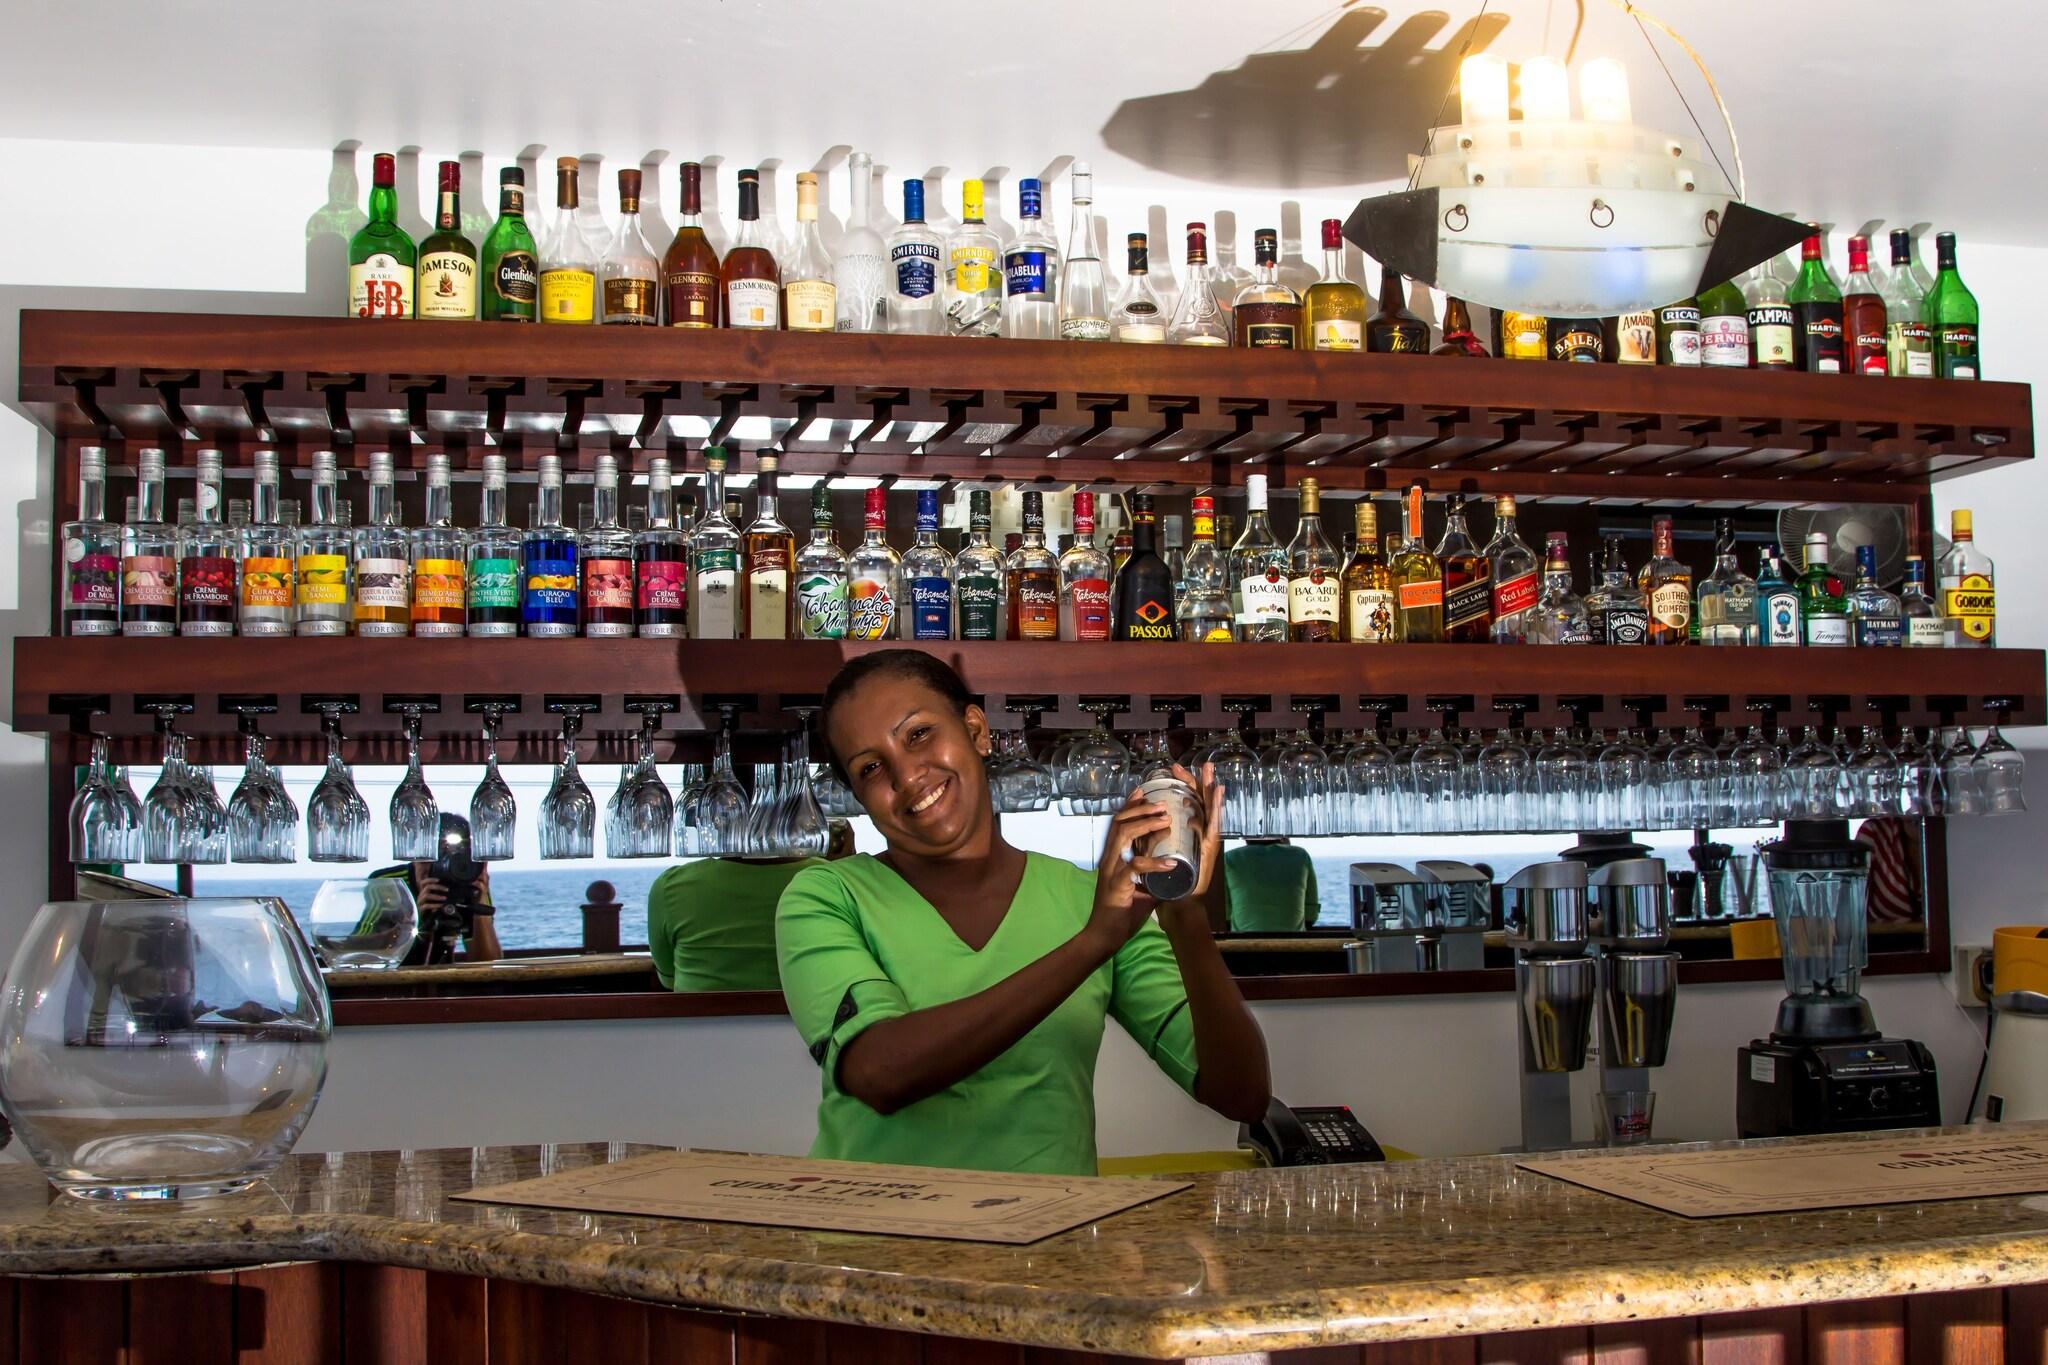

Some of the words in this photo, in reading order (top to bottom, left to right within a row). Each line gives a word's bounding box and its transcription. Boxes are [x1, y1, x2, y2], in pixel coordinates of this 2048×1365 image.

[893, 244, 938, 259] SMIRNOFF
[421, 259, 472, 276] JAMESON
[359, 280, 404, 319] J&B
[1810, 325, 1841, 333] MARTINI
[1554, 334, 1603, 354] BAILEYS
[1945, 333, 1977, 342] MARTINI
[193, 593, 229, 601] FRAMBOISE
[537, 590, 570, 598] CURAÇAO
[1357, 594, 1380, 605] Captain
[1500, 591, 1516, 603] Red
[1517, 584, 1536, 597] Label
[1448, 598, 1470, 610] BLACK
[1611, 617, 1626, 630] JACK
[709, 1179, 803, 1192] CUBA
[810, 1186, 953, 1202] LIBRE
